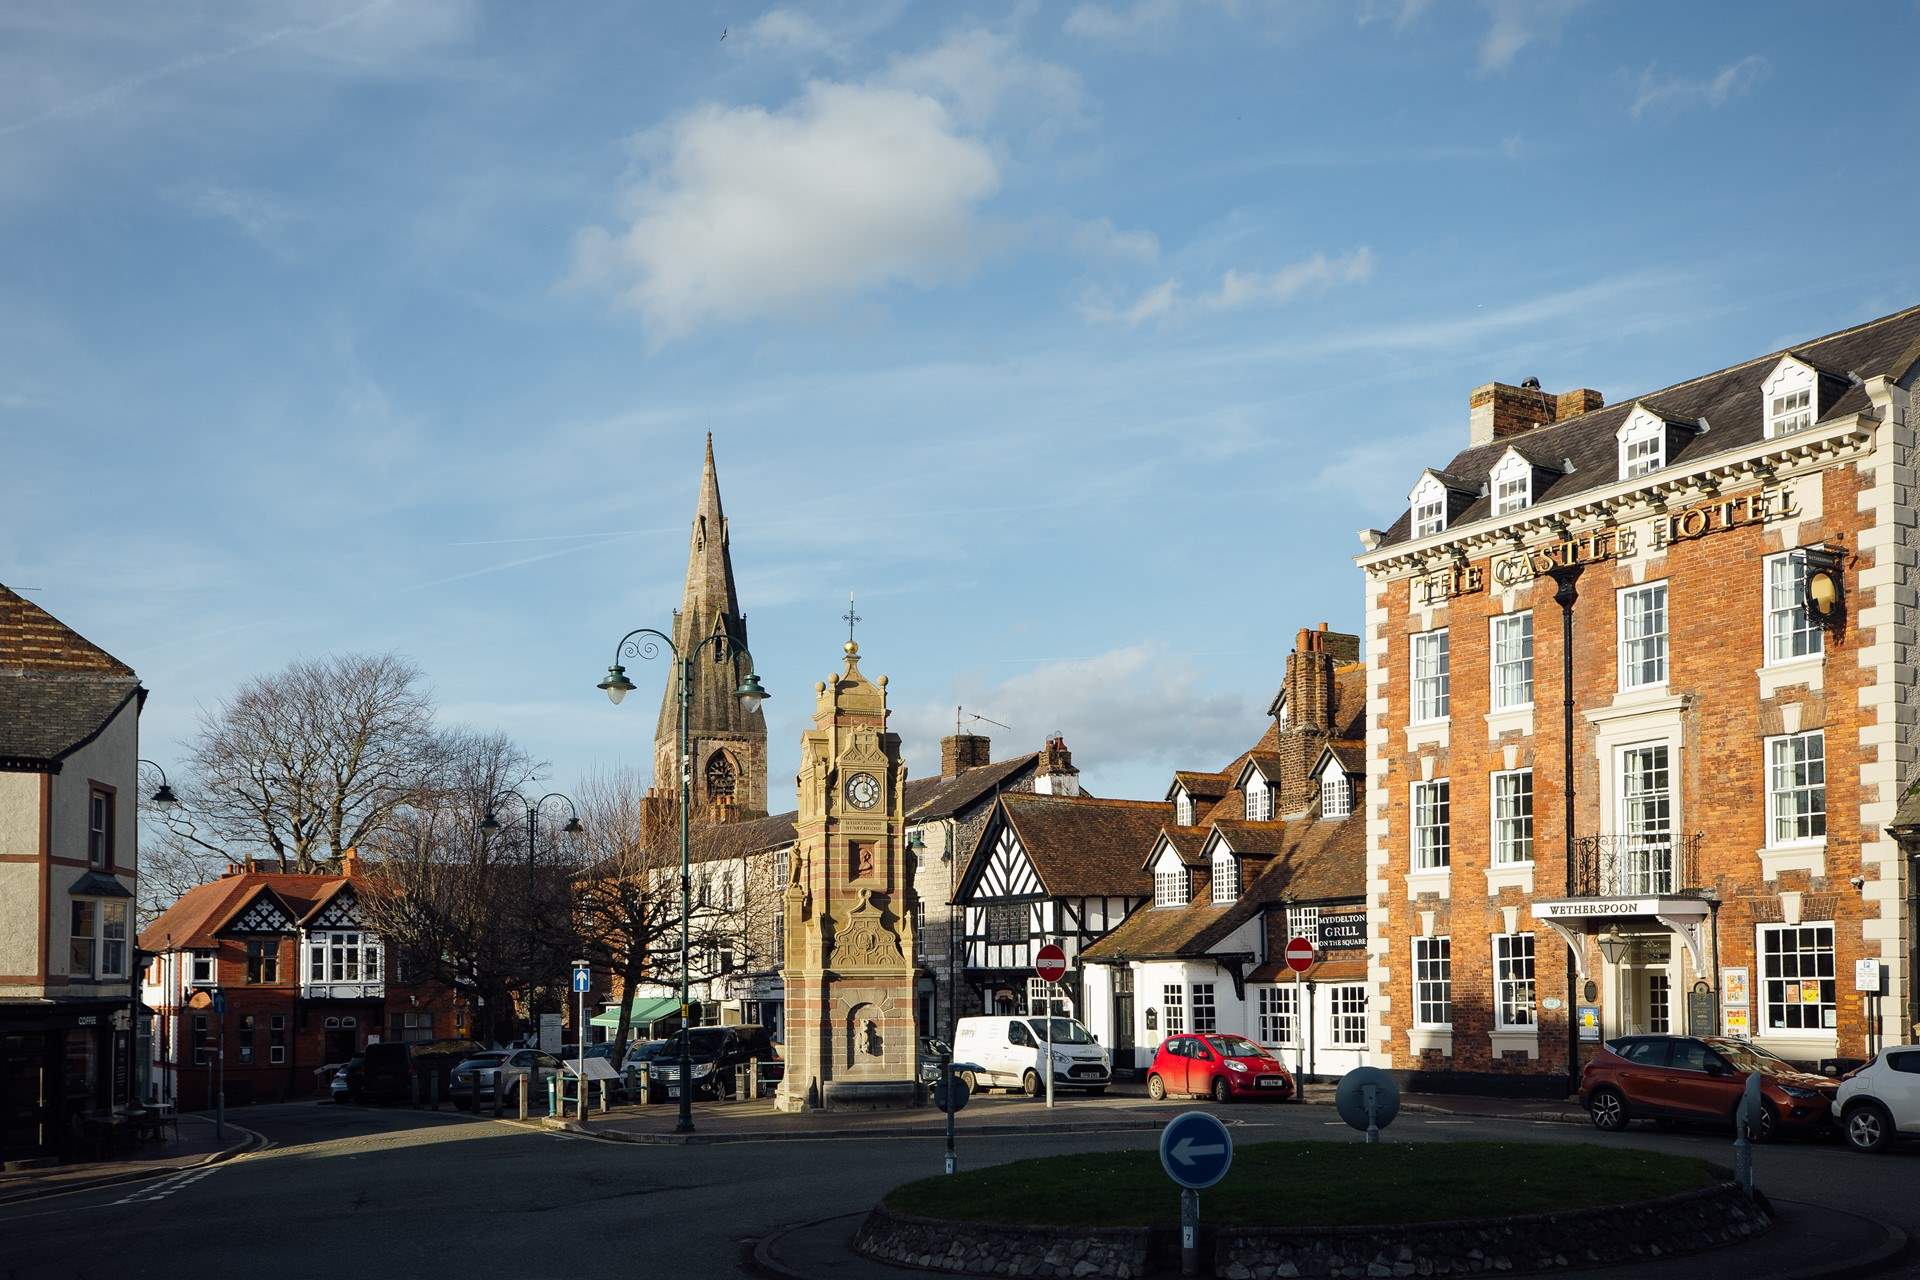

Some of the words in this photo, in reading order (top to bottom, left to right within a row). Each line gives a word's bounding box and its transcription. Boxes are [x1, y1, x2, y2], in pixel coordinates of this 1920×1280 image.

[1415, 565, 1482, 602] THE
[1494, 525, 1634, 585] CASTLE
[1648, 485, 1797, 548] HOTEL
[1549, 903, 1638, 915] WETHERSPOON
[1318, 914, 1366, 924] MYDDELTON
[1324, 926, 1360, 937] GRILL
[1329, 939, 1342, 947] THE
[1342, 938, 1366, 947] SQUARE
[1185, 1233, 1191, 1241] 7
